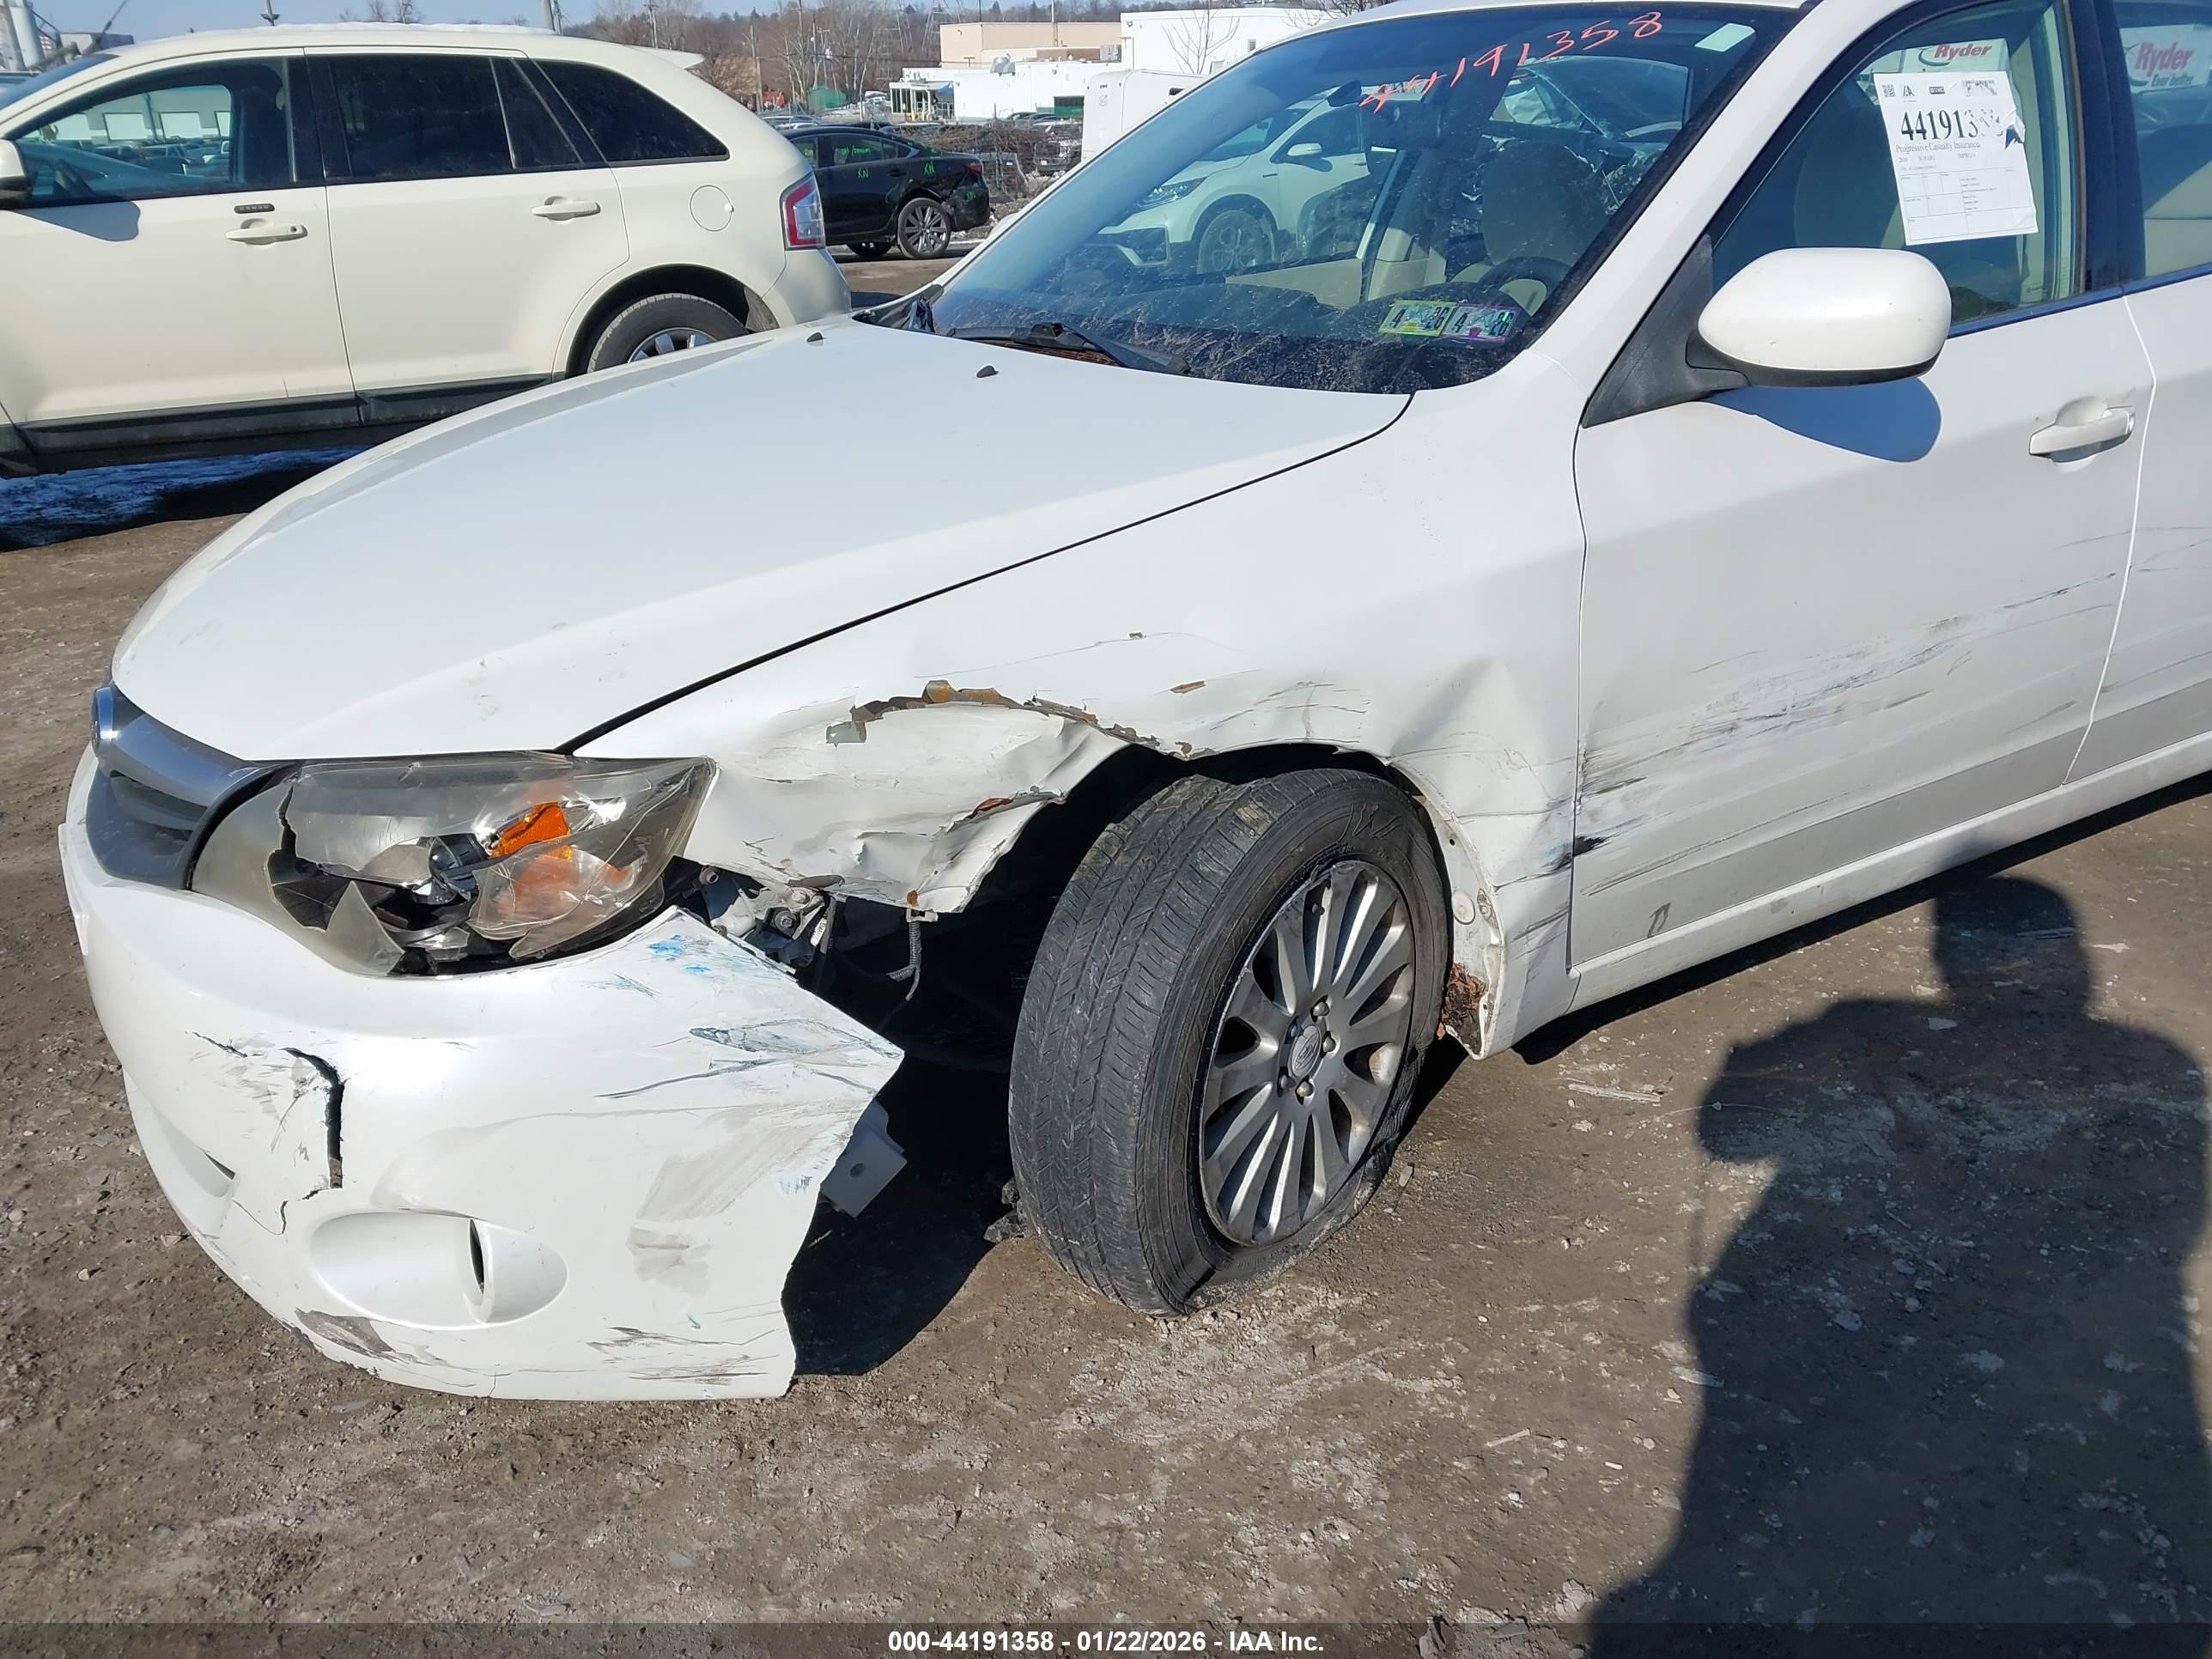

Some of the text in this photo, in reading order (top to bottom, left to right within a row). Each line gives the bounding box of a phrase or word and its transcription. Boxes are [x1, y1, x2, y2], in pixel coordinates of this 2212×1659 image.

[1934, 43, 1992, 61] Ryder
[2136, 41, 2195, 77] Ryder
[1896, 144, 1928, 154] Progressive
[1929, 143, 1952, 152] Casualty
[1389, 308, 1407, 329] 4
